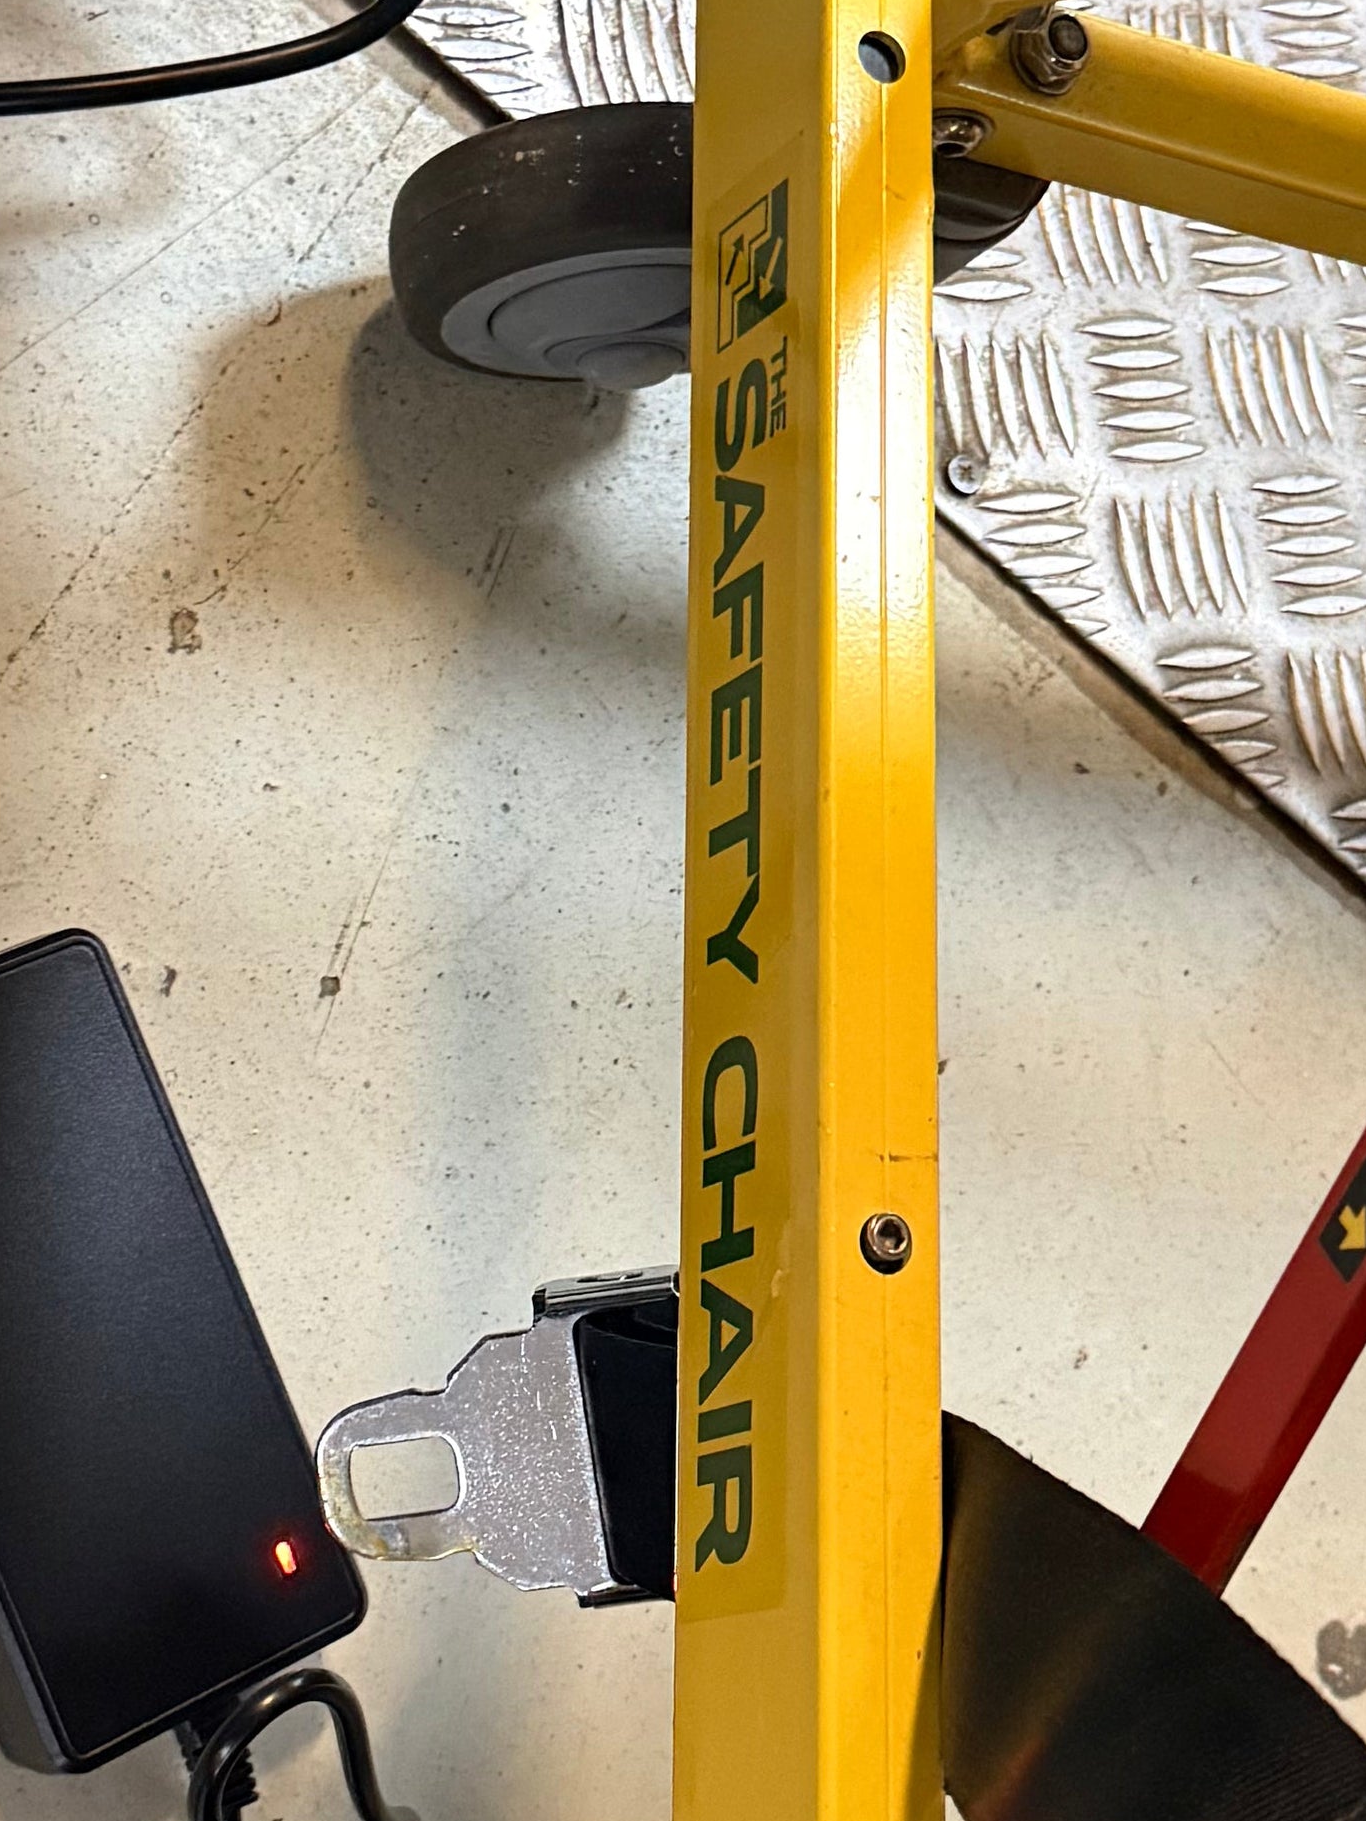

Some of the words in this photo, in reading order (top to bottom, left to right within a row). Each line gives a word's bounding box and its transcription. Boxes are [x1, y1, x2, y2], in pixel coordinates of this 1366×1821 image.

[768, 334, 787, 439] THE
[706, 357, 769, 985] SAFETY
[694, 1035, 759, 1573] CHAIR
